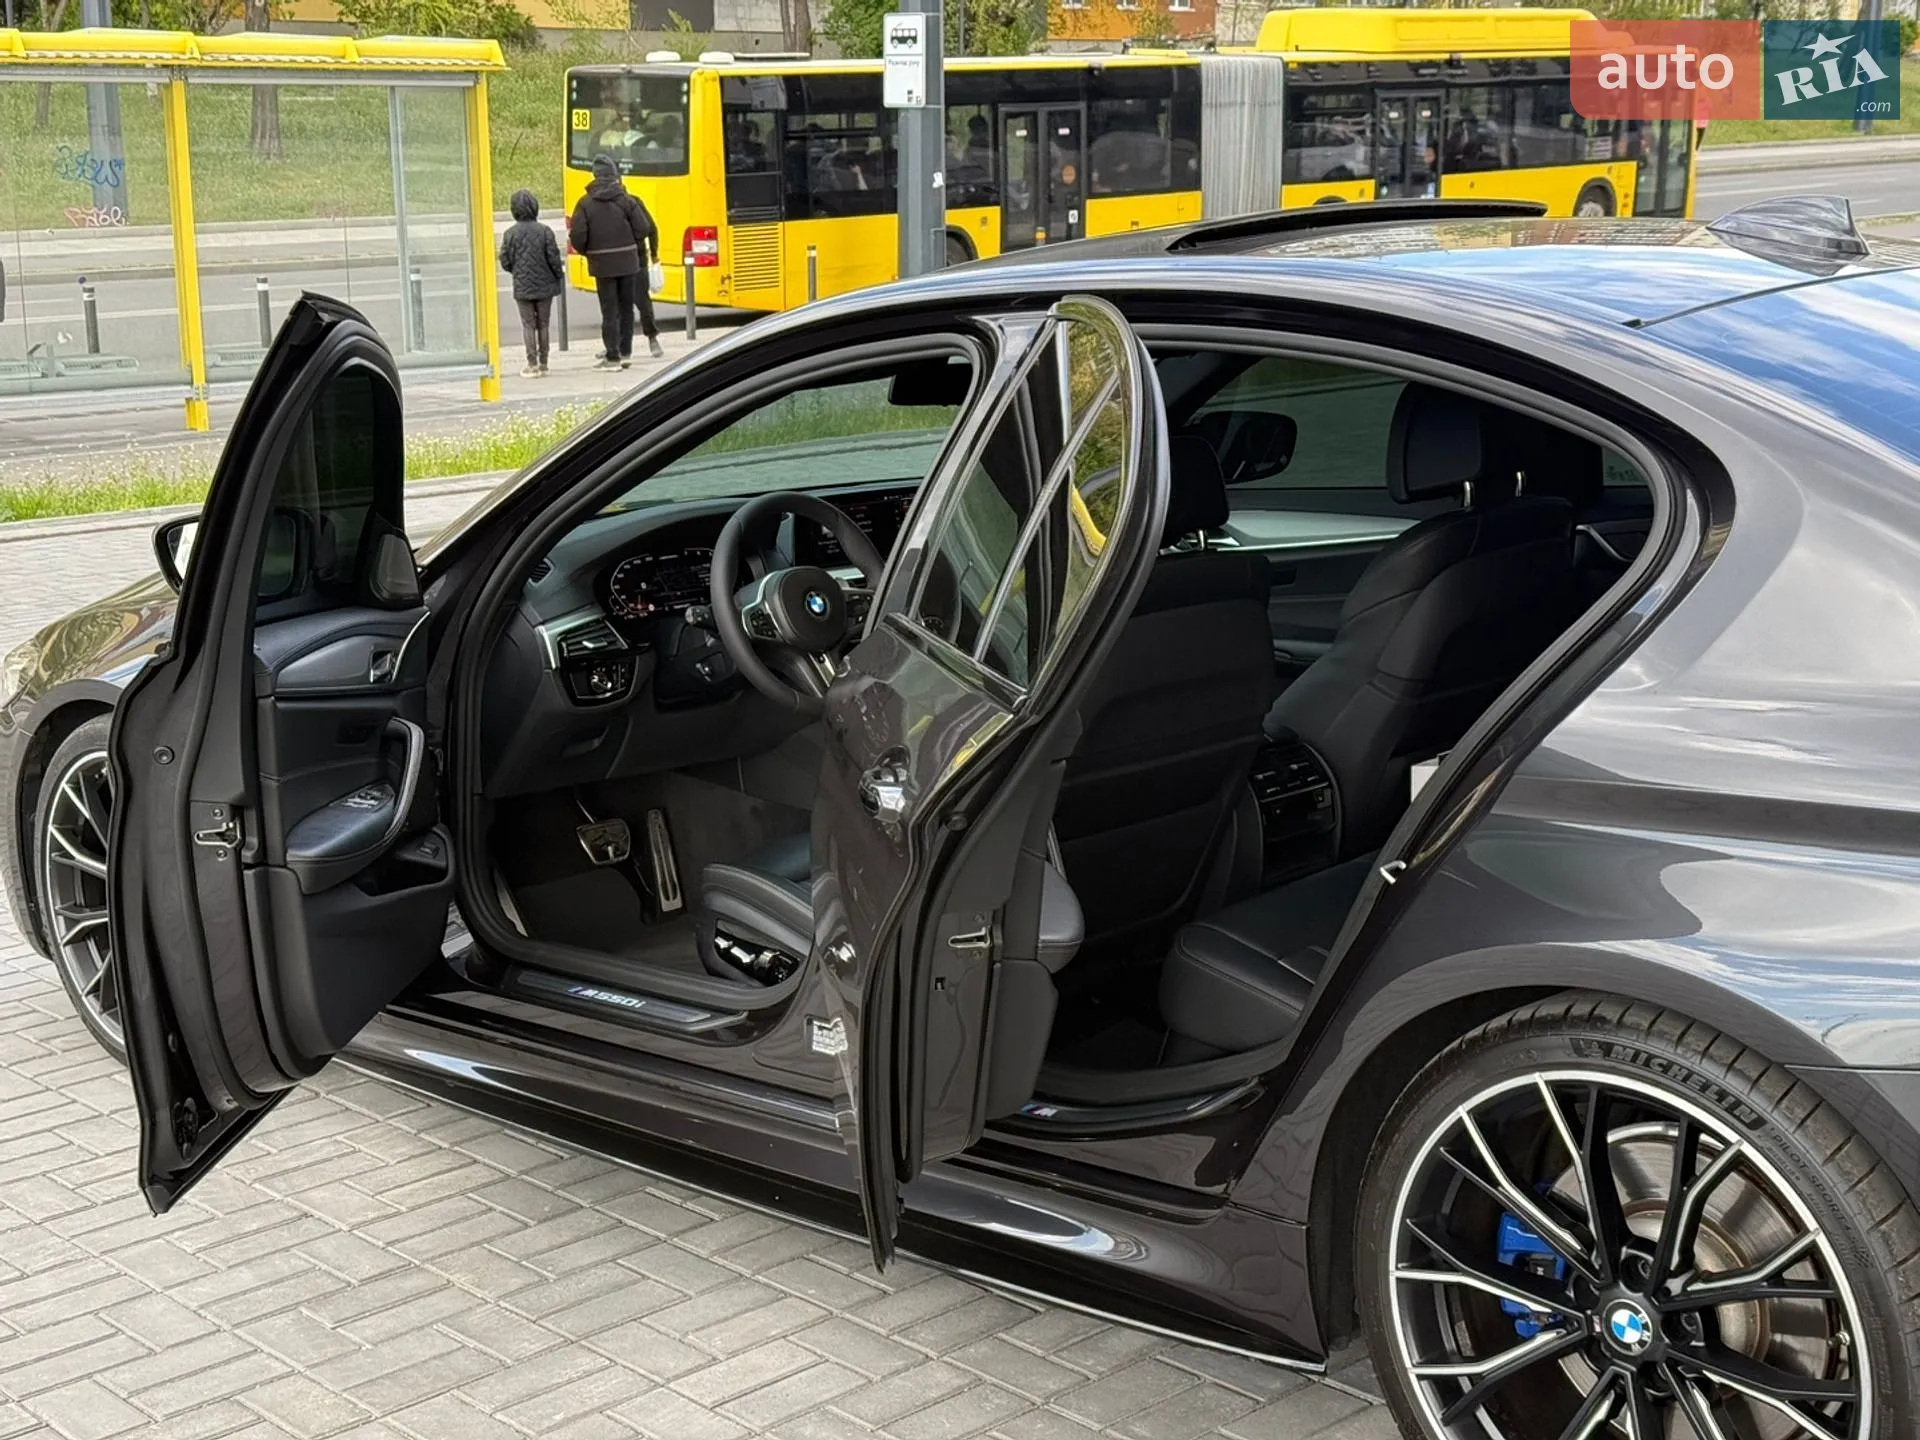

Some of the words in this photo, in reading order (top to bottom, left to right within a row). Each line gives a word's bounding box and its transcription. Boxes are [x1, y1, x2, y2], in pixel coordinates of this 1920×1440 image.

[574, 111, 588, 128] 38
[1611, 1045, 1759, 1127] MICHELIN
[1773, 1134, 1809, 1170] PILOT
[1809, 1174, 1847, 1222] SPORT
